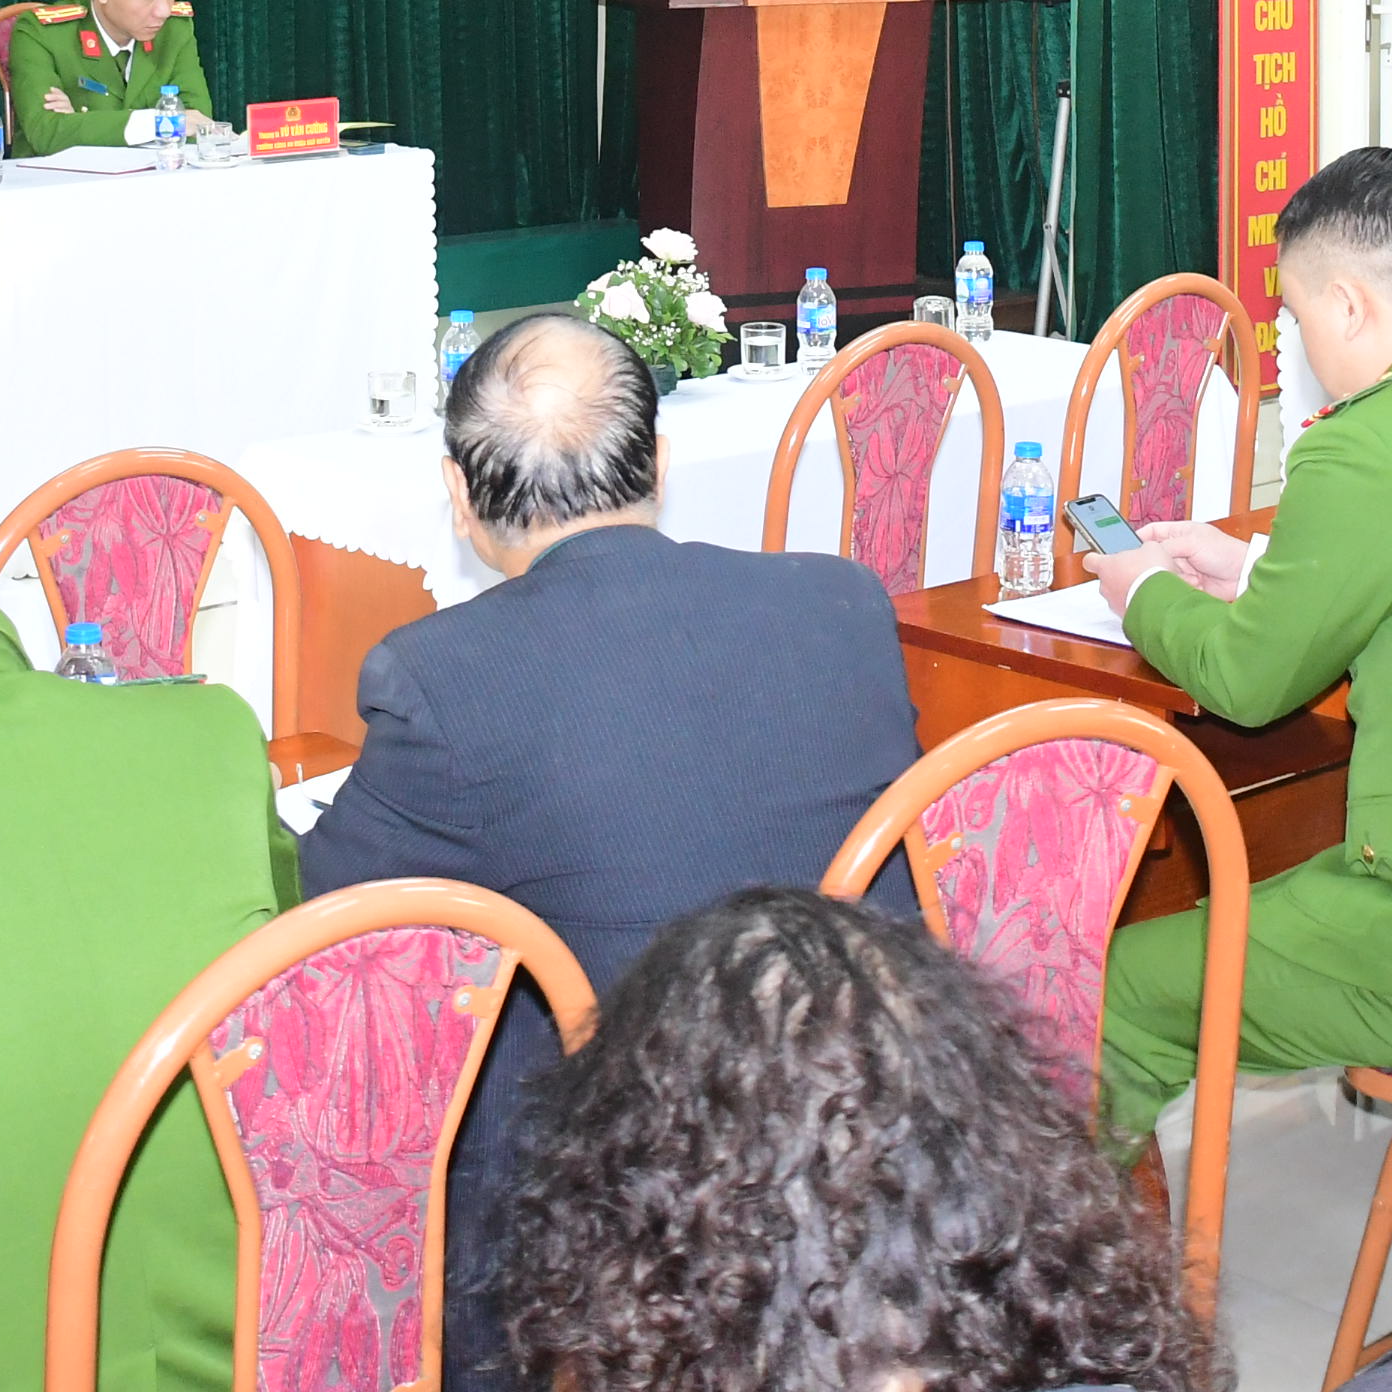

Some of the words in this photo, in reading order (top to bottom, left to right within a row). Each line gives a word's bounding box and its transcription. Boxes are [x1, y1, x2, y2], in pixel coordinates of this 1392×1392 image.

[1253, 52, 1295, 89] TỊCH
[1260, 93, 1286, 138] HỒ
[1256, 152, 1286, 192] CHÍ
